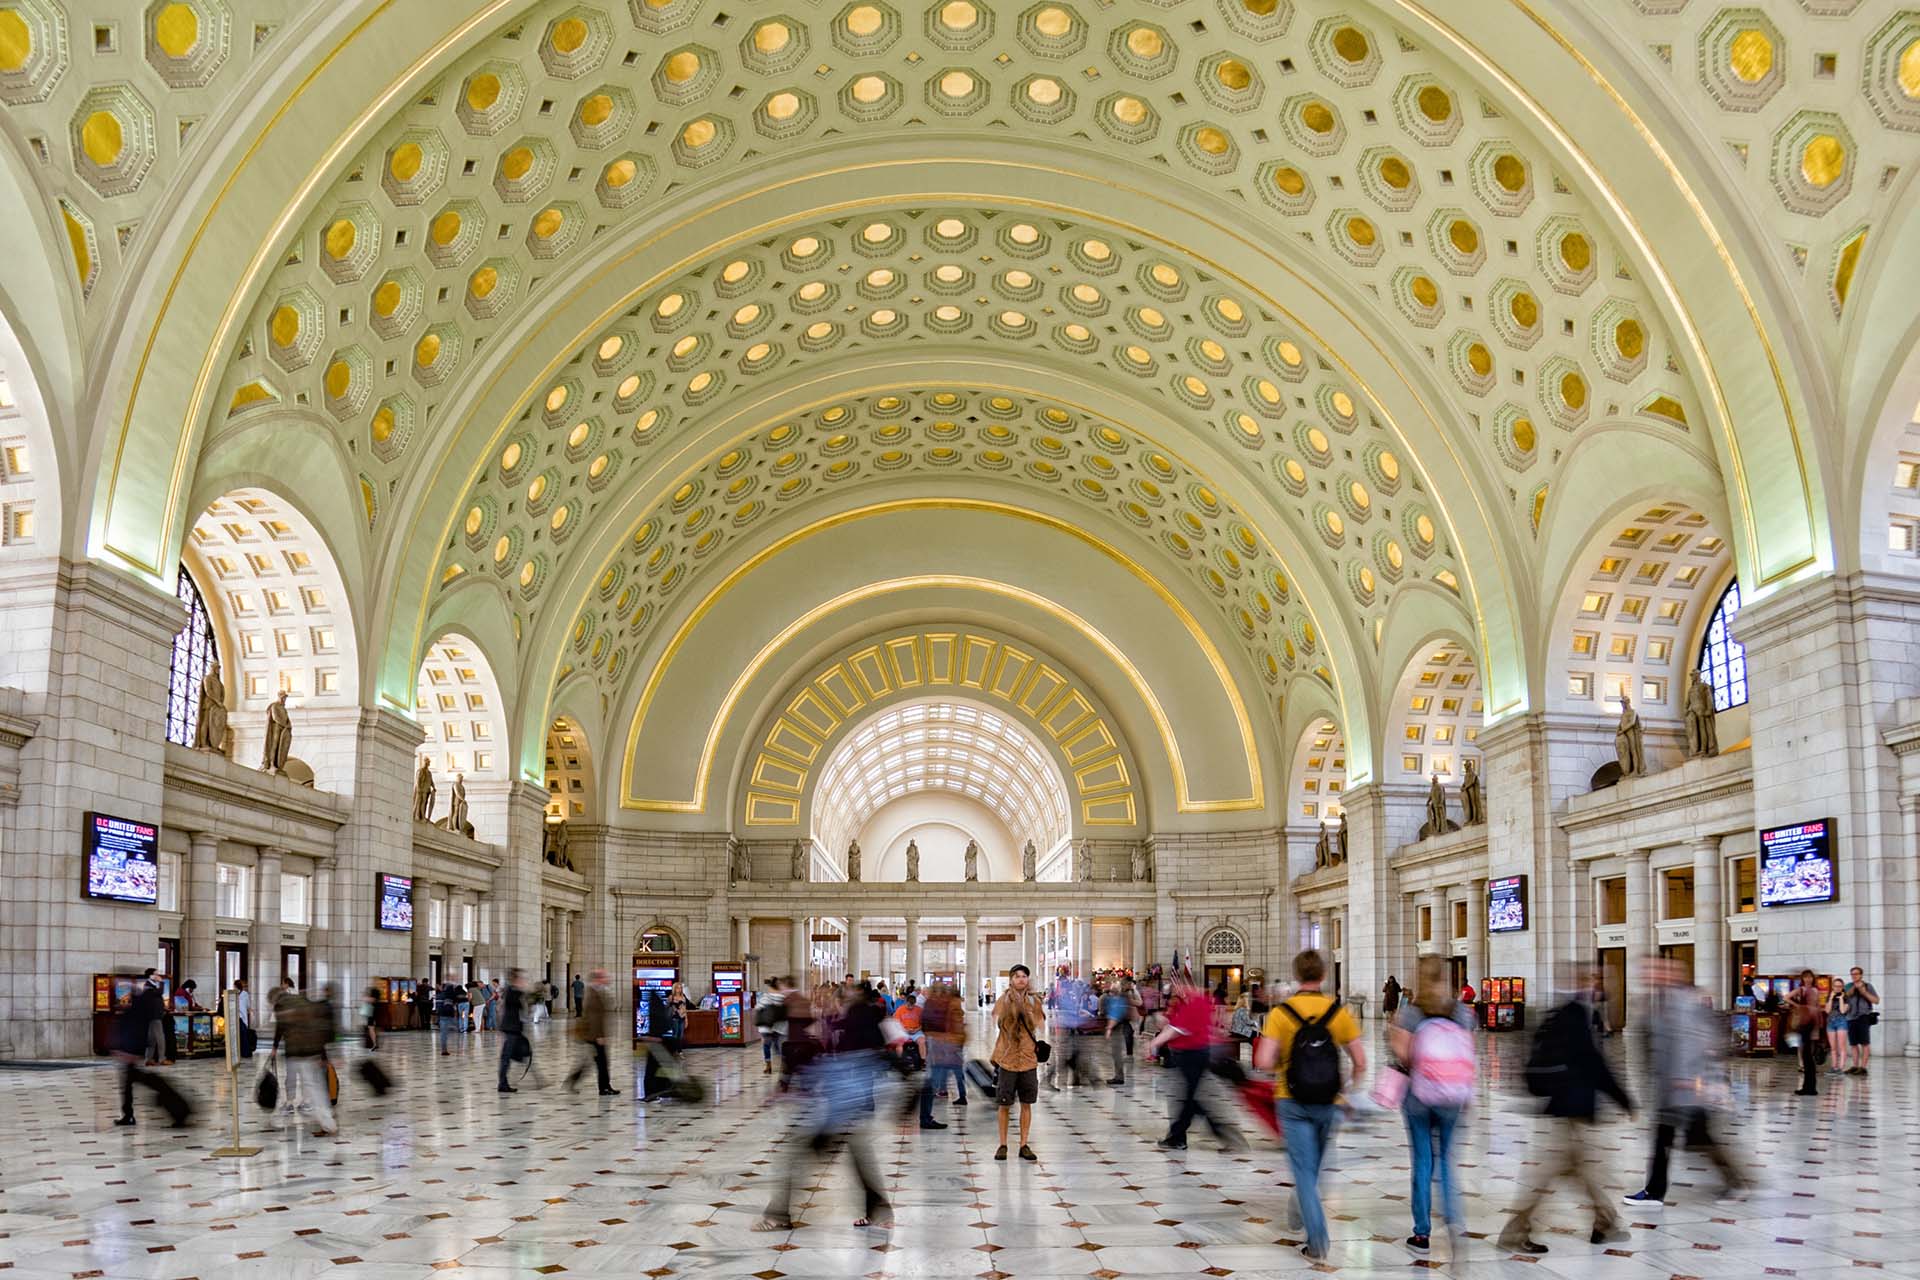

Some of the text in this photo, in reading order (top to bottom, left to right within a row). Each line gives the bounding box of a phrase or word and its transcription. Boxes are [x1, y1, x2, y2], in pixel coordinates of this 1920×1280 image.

[108, 820, 136, 832] UNITED
[136, 825, 154, 836] FANS
[1775, 826, 1803, 838] UNITED
[1803, 823, 1824, 834] FANS
